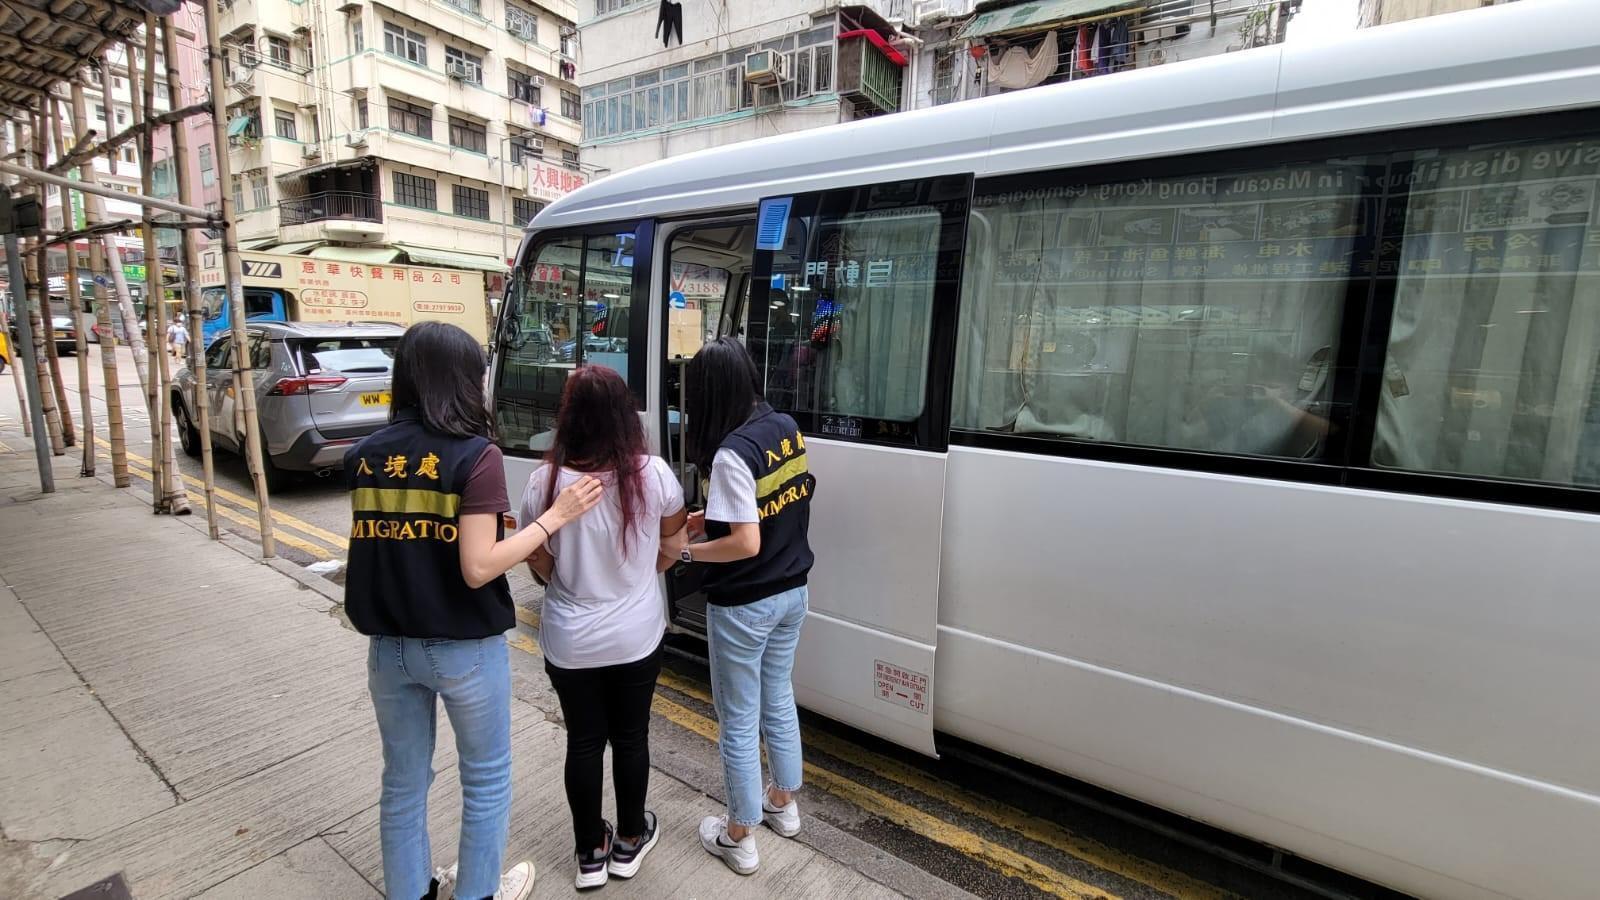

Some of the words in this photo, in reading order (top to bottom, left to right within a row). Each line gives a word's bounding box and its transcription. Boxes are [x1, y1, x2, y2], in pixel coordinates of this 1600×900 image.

[682, 282, 720, 294] 3188
[362, 394, 380, 405] WW
[356, 452, 440, 479] 入境處
[351, 519, 459, 543] MIGRATIO
[878, 681, 894, 692] OPEN
[910, 700, 925, 711] CUT
